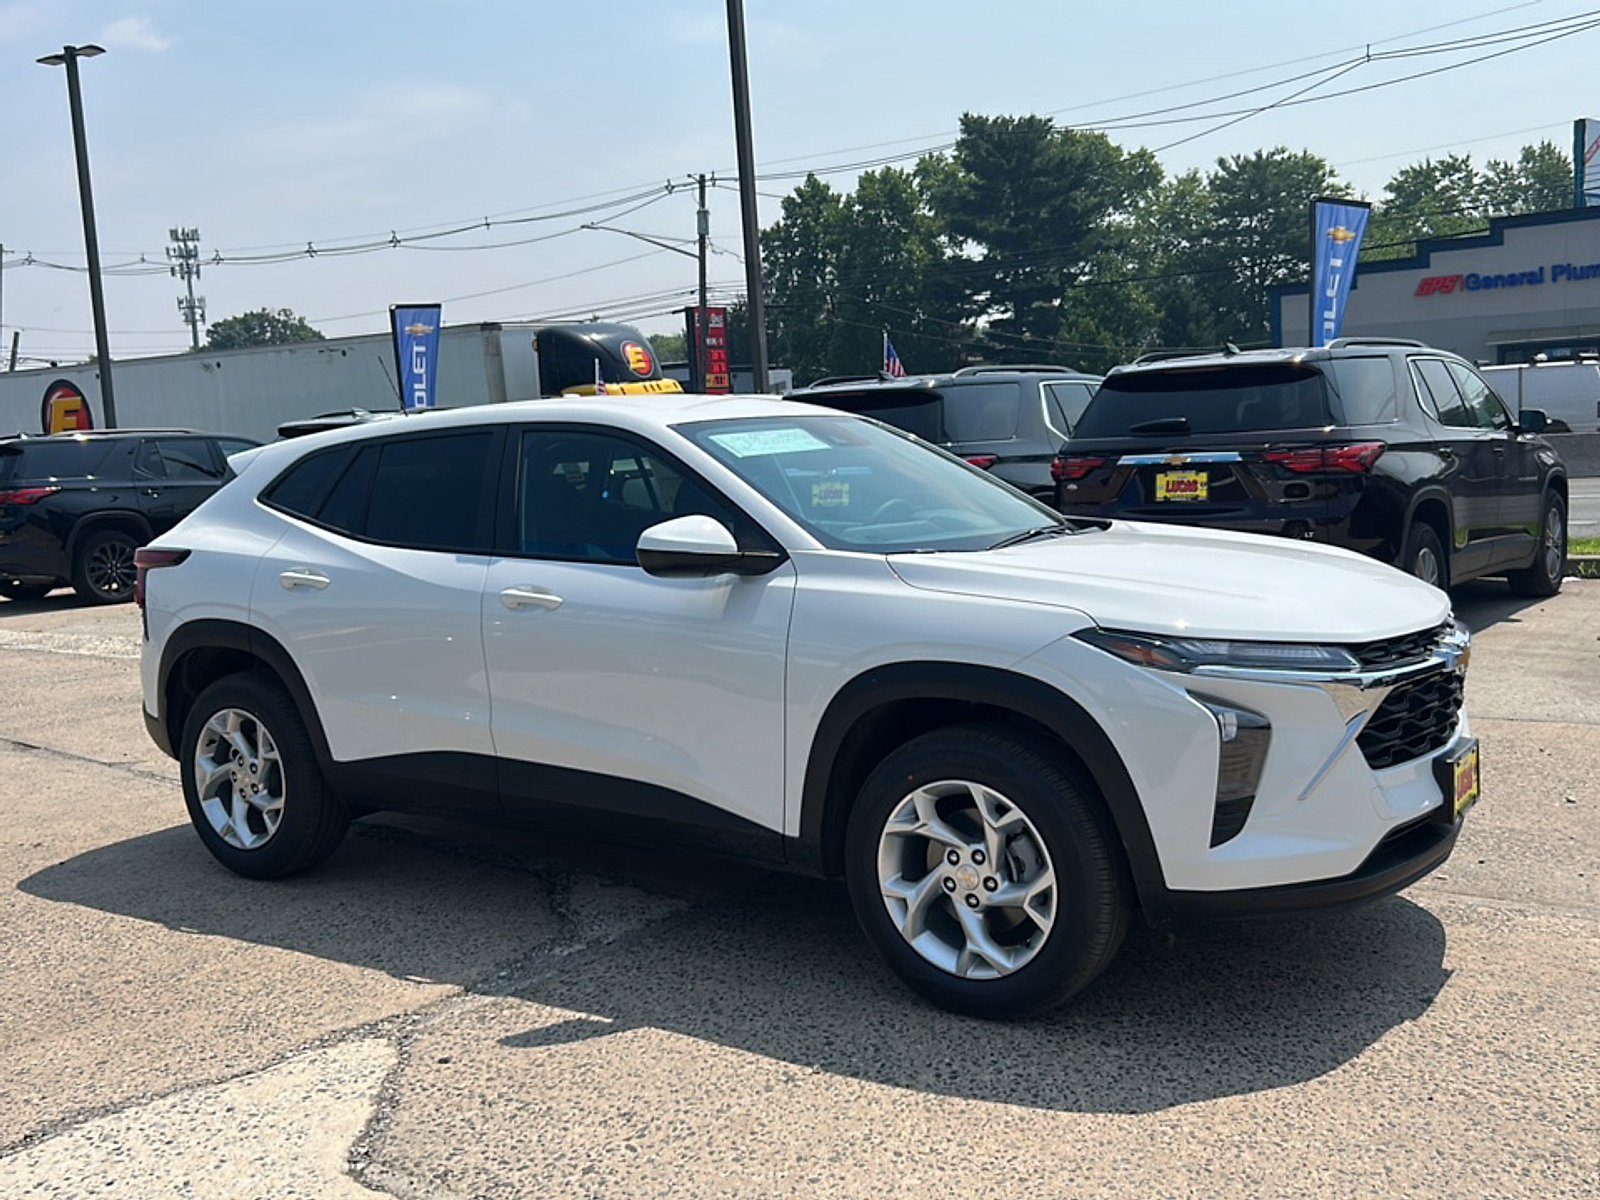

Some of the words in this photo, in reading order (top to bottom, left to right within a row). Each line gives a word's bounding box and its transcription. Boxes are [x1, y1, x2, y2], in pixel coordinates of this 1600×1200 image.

[1464, 265, 1544, 291] General
[628, 347, 647, 370] E
[1165, 479, 1199, 493] LUCAS
